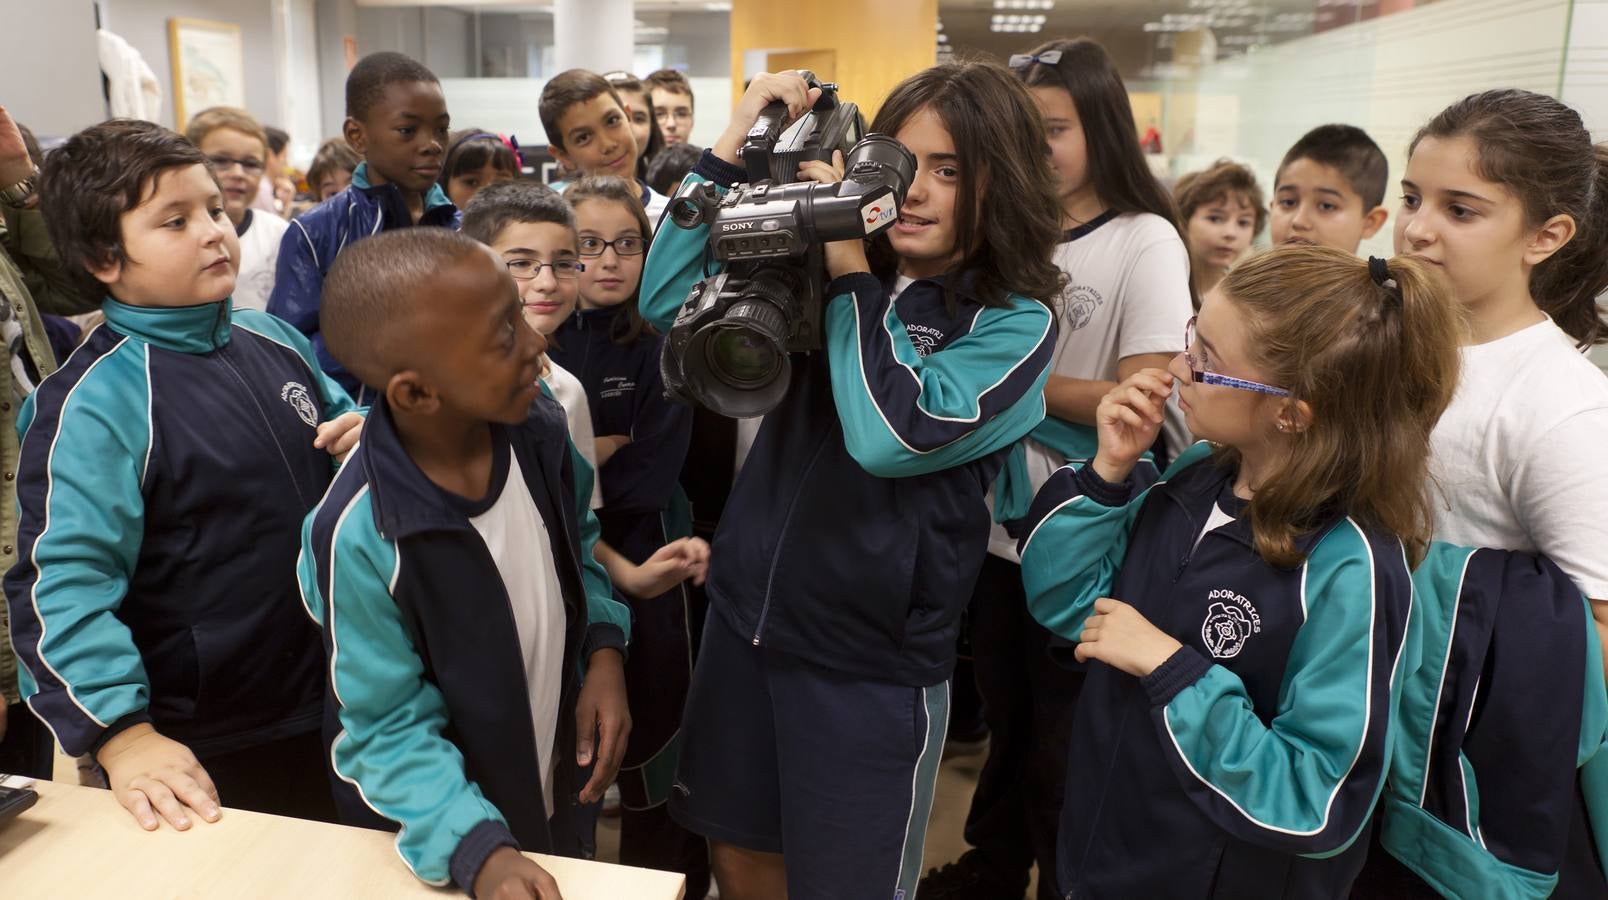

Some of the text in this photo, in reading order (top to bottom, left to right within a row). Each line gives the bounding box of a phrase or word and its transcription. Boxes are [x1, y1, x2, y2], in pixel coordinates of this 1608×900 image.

[722, 222, 754, 232] SONY
[906, 324, 944, 340] ADORATRI
[1208, 589, 1261, 634] ADORATRICES
